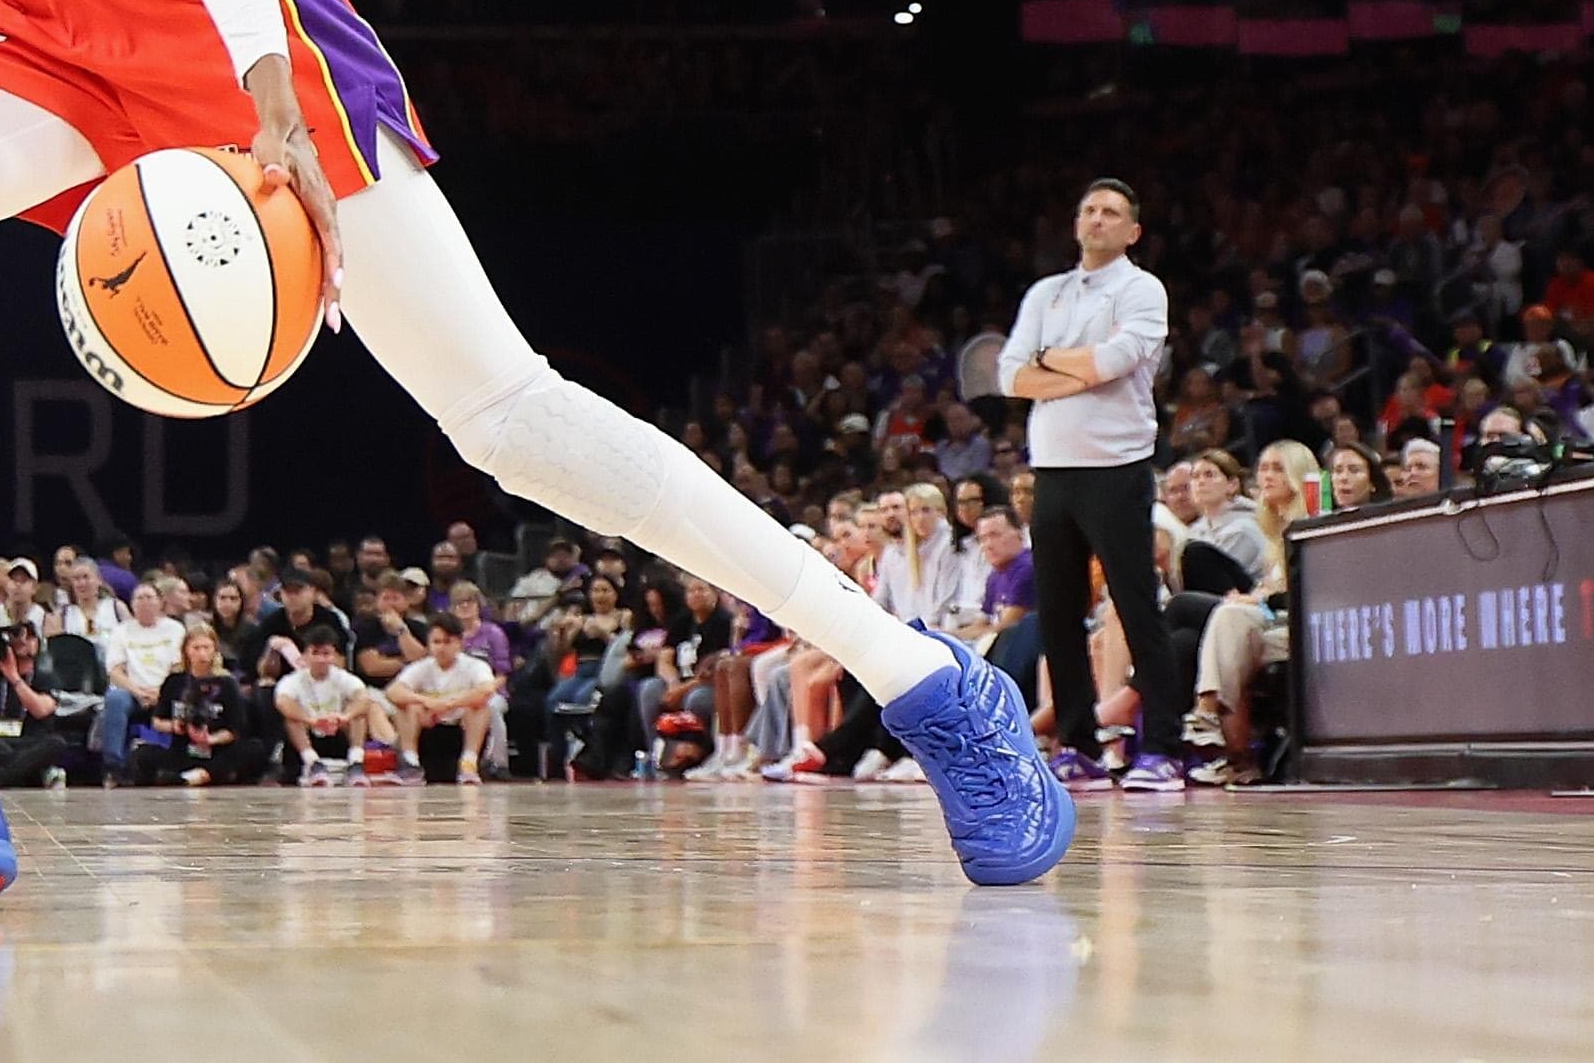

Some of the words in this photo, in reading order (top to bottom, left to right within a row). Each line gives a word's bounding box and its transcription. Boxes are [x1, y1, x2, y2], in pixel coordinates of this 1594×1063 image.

[1310, 602, 1395, 663] THERE'S
[1403, 593, 1468, 656] MORE
[1477, 583, 1566, 649] WHERE
